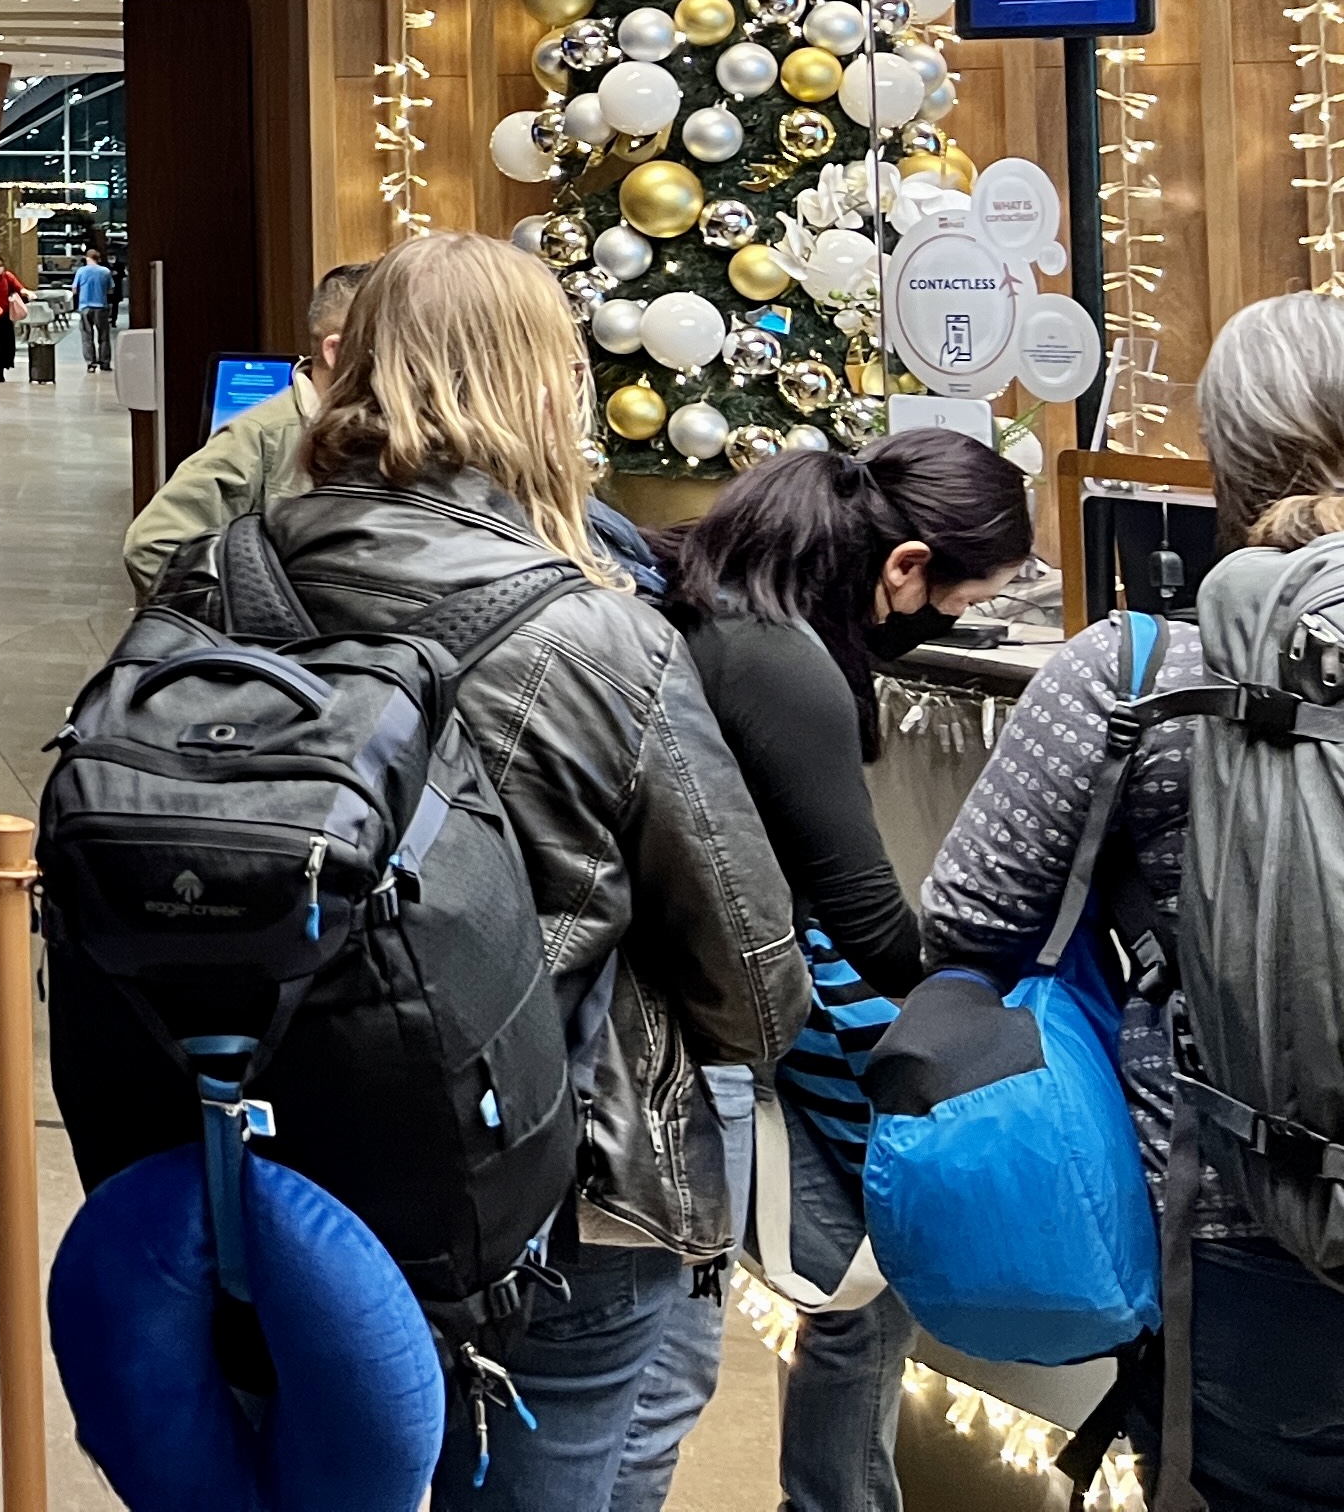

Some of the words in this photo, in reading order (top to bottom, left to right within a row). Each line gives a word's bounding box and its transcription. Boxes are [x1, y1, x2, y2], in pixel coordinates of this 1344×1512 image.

[992, 200, 1022, 211] WHAT
[1023, 200, 1033, 210] IS
[909, 278, 997, 290] CONTACTLESS
[144, 899, 191, 919] eagle
